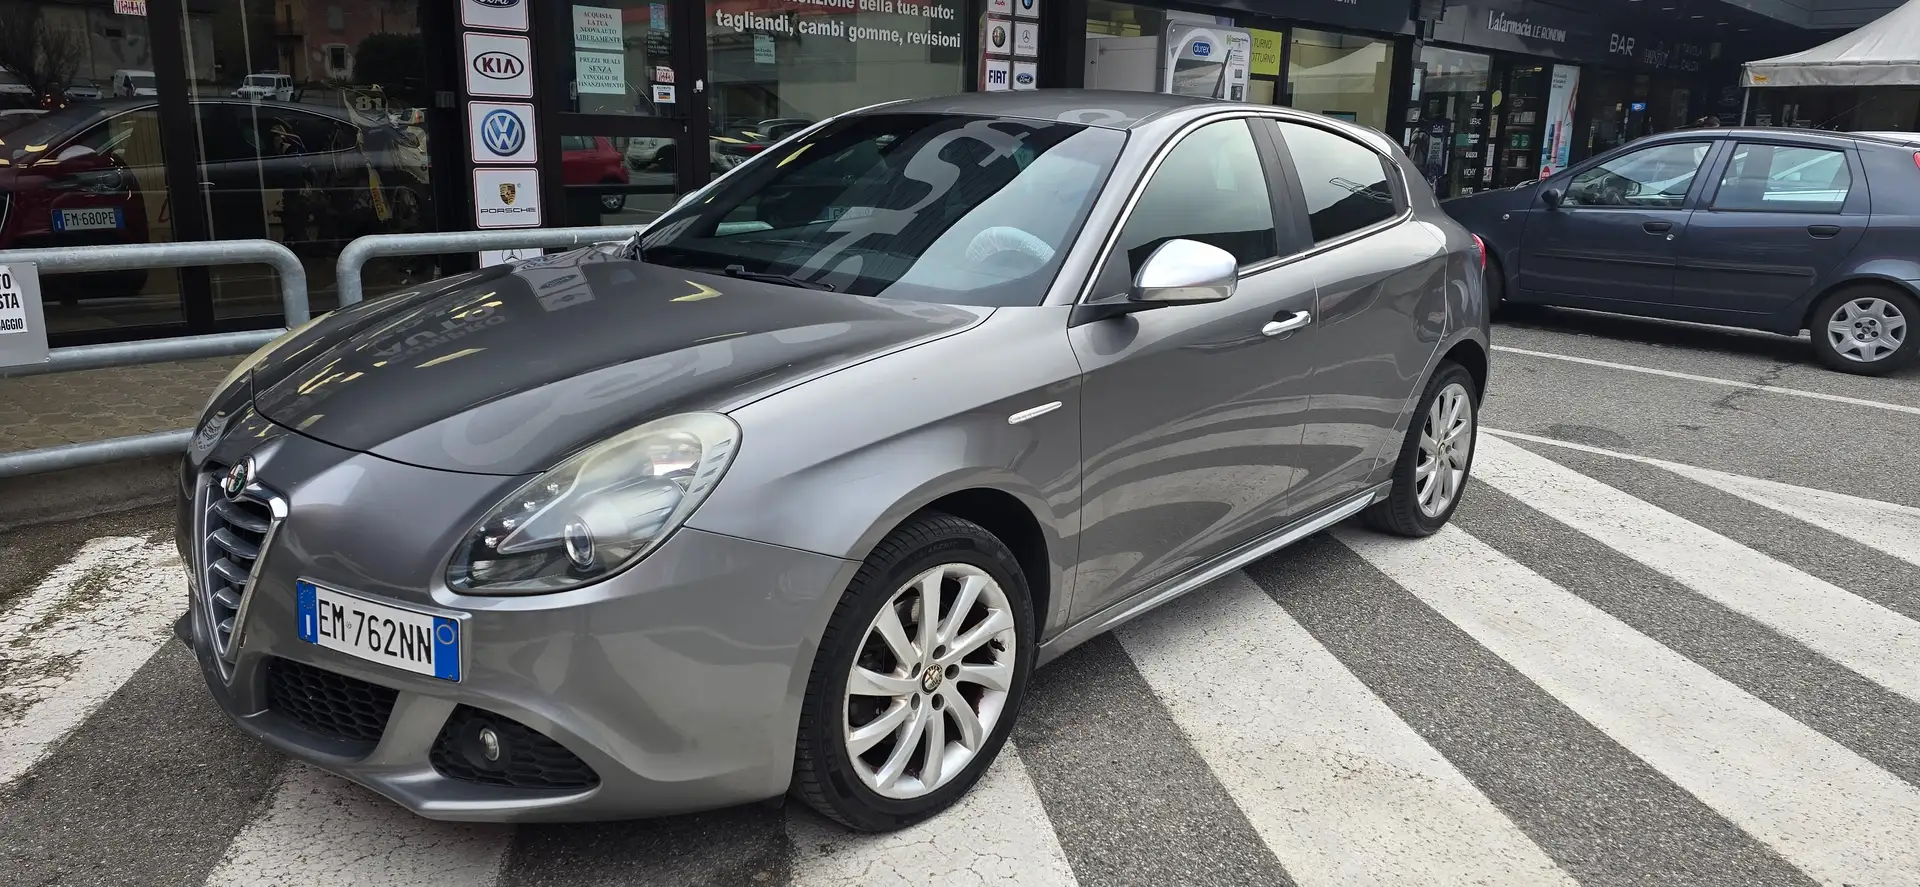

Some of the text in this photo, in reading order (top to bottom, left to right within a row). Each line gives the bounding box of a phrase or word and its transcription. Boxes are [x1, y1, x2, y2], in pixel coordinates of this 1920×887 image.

[584, 11, 613, 20] ACQUISTA
[897, 0, 918, 16] tua
[922, 4, 954, 20] auto:
[715, 8, 961, 48] tagliandi, cambi gomme, revisioni
[576, 34, 622, 43] LIBERAMENTE
[1253, 38, 1273, 50] TURNO
[1194, 43, 1210, 55] durex
[1609, 33, 1636, 57] BAR
[1251, 52, 1276, 64] OTTURNO
[482, 57, 516, 74] KIA
[588, 66, 612, 74] SENZA
[989, 69, 1007, 84] FIAT
[578, 81, 624, 89] FINANZIAMENTO
[0, 317, 24, 331] AGGIO
